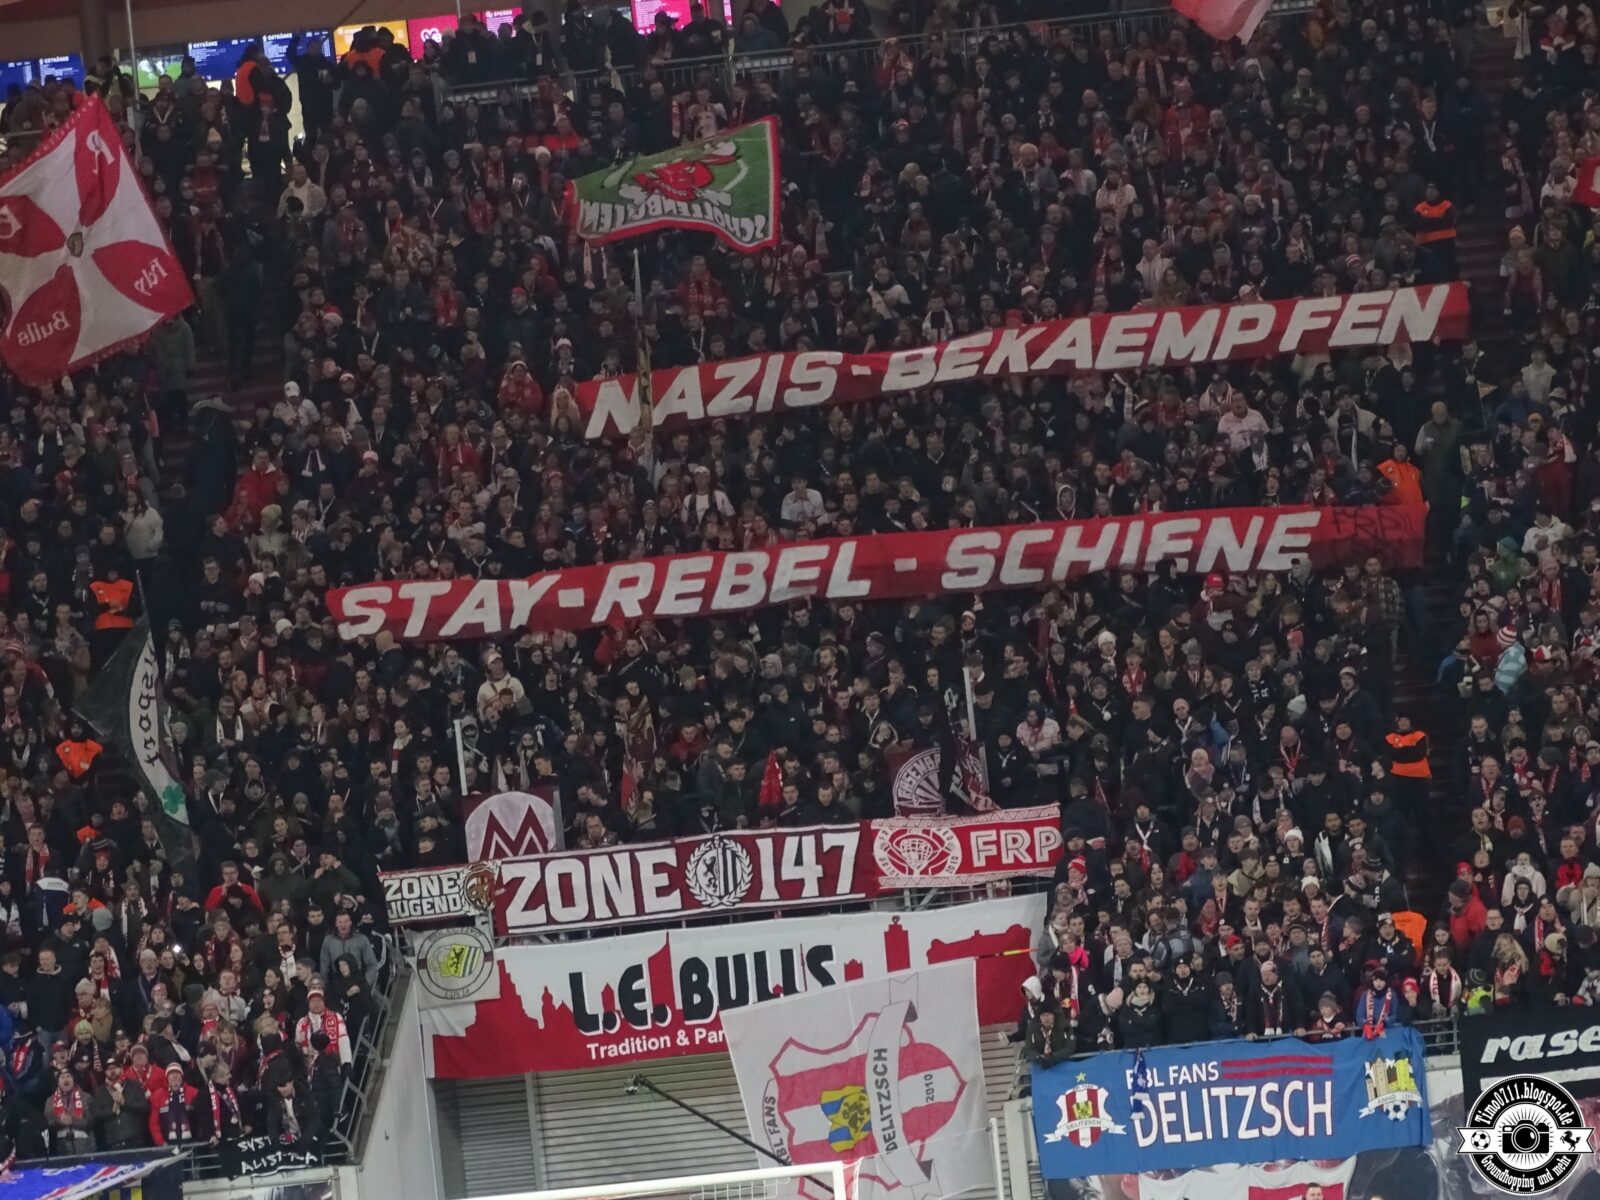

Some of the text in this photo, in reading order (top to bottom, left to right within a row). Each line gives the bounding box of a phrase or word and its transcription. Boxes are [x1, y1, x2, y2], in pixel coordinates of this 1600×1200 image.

[941, 511, 1322, 590] SCHIENE
[969, 825, 1065, 868] FRP
[383, 872, 462, 901] ZONE
[501, 831, 861, 928] ZONE 147
[386, 893, 462, 920] JUGEND
[569, 963, 673, 1036] L.E.
[587, 1030, 672, 1061] Tradition
[676, 1030, 690, 1047] &
[923, 1073, 936, 1104] 2010
[1168, 1060, 1220, 1087] FANS
[764, 1096, 782, 1135] FANS
[872, 1047, 899, 1156] DELITZSCH
[1130, 1079, 1334, 1149] DELITZSCH
